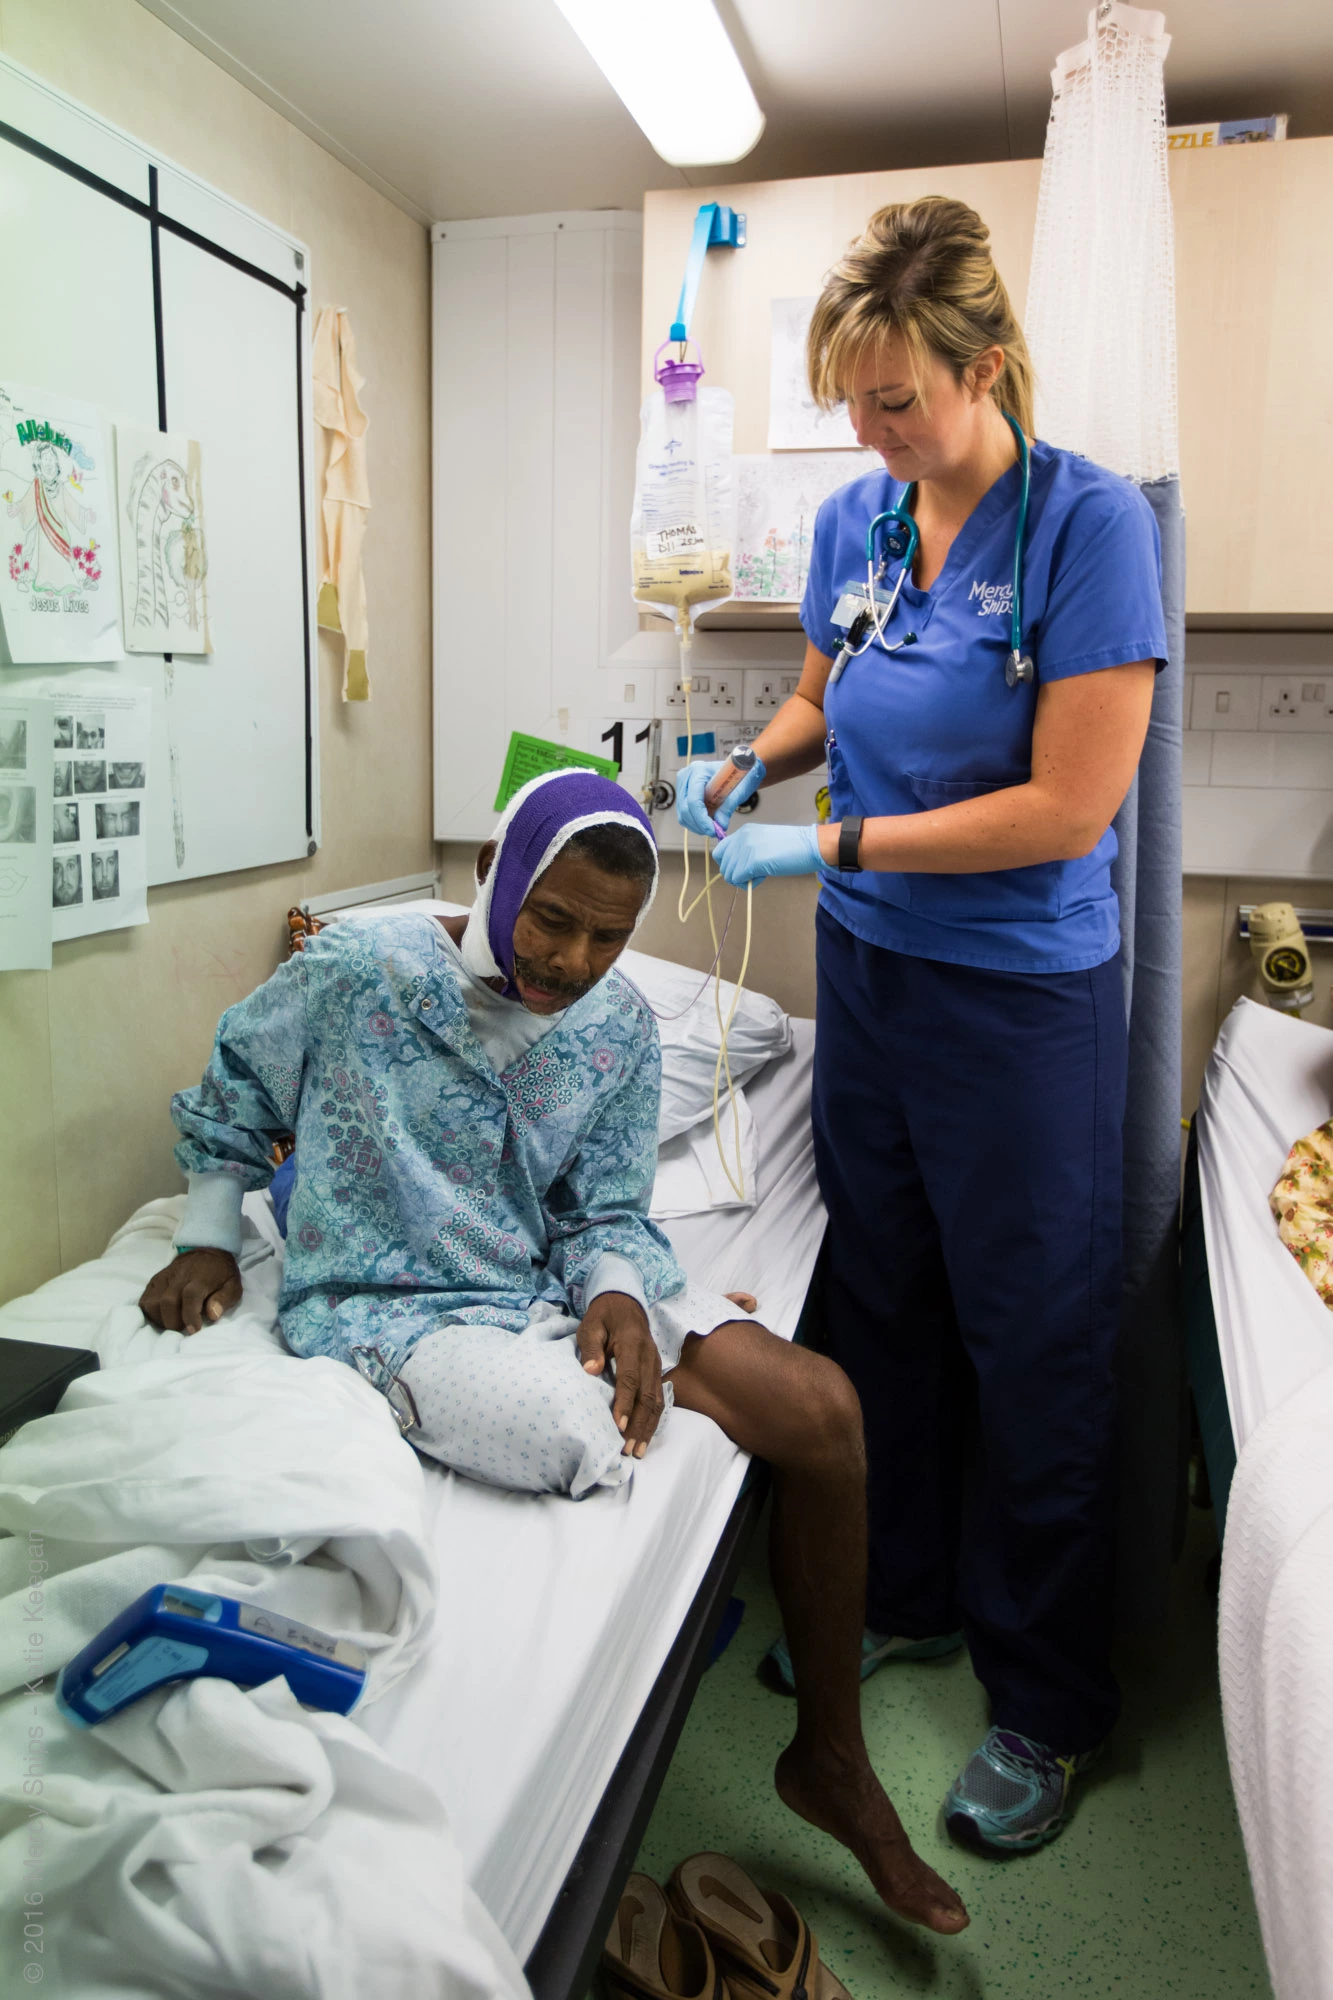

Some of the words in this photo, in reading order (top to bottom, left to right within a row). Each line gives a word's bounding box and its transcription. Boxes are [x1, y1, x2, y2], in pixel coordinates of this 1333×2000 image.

[1167, 131, 1214, 150] ZZLE
[657, 525, 697, 542] THOMAS
[968, 580, 1013, 600] Mercy
[29, 594, 60, 612] Jesus
[63, 596, 89, 613] Lives
